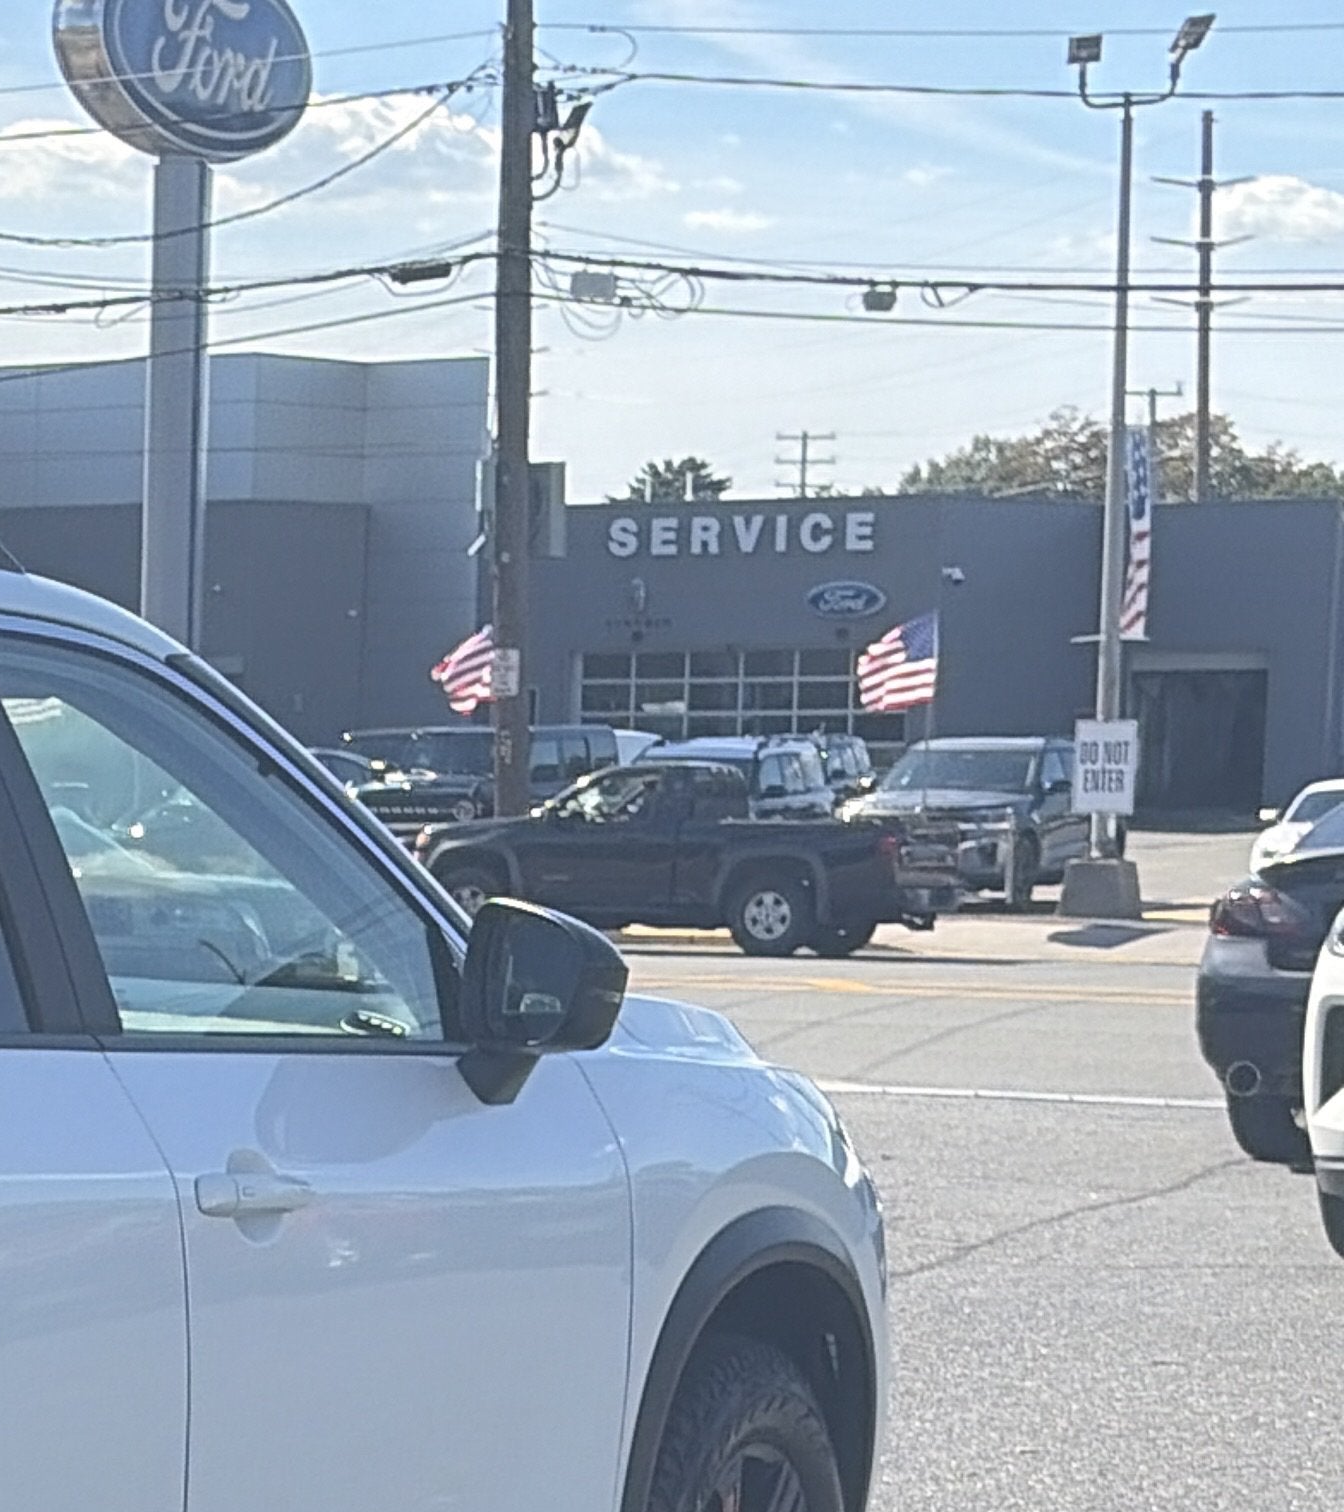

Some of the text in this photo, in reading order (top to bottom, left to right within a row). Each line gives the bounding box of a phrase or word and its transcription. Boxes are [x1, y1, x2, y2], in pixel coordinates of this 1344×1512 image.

[151, 0, 279, 113] Ford
[607, 511, 875, 557] SERVICE
[1079, 741, 1129, 765] DO NOT
[1083, 768, 1125, 793] ENTER
